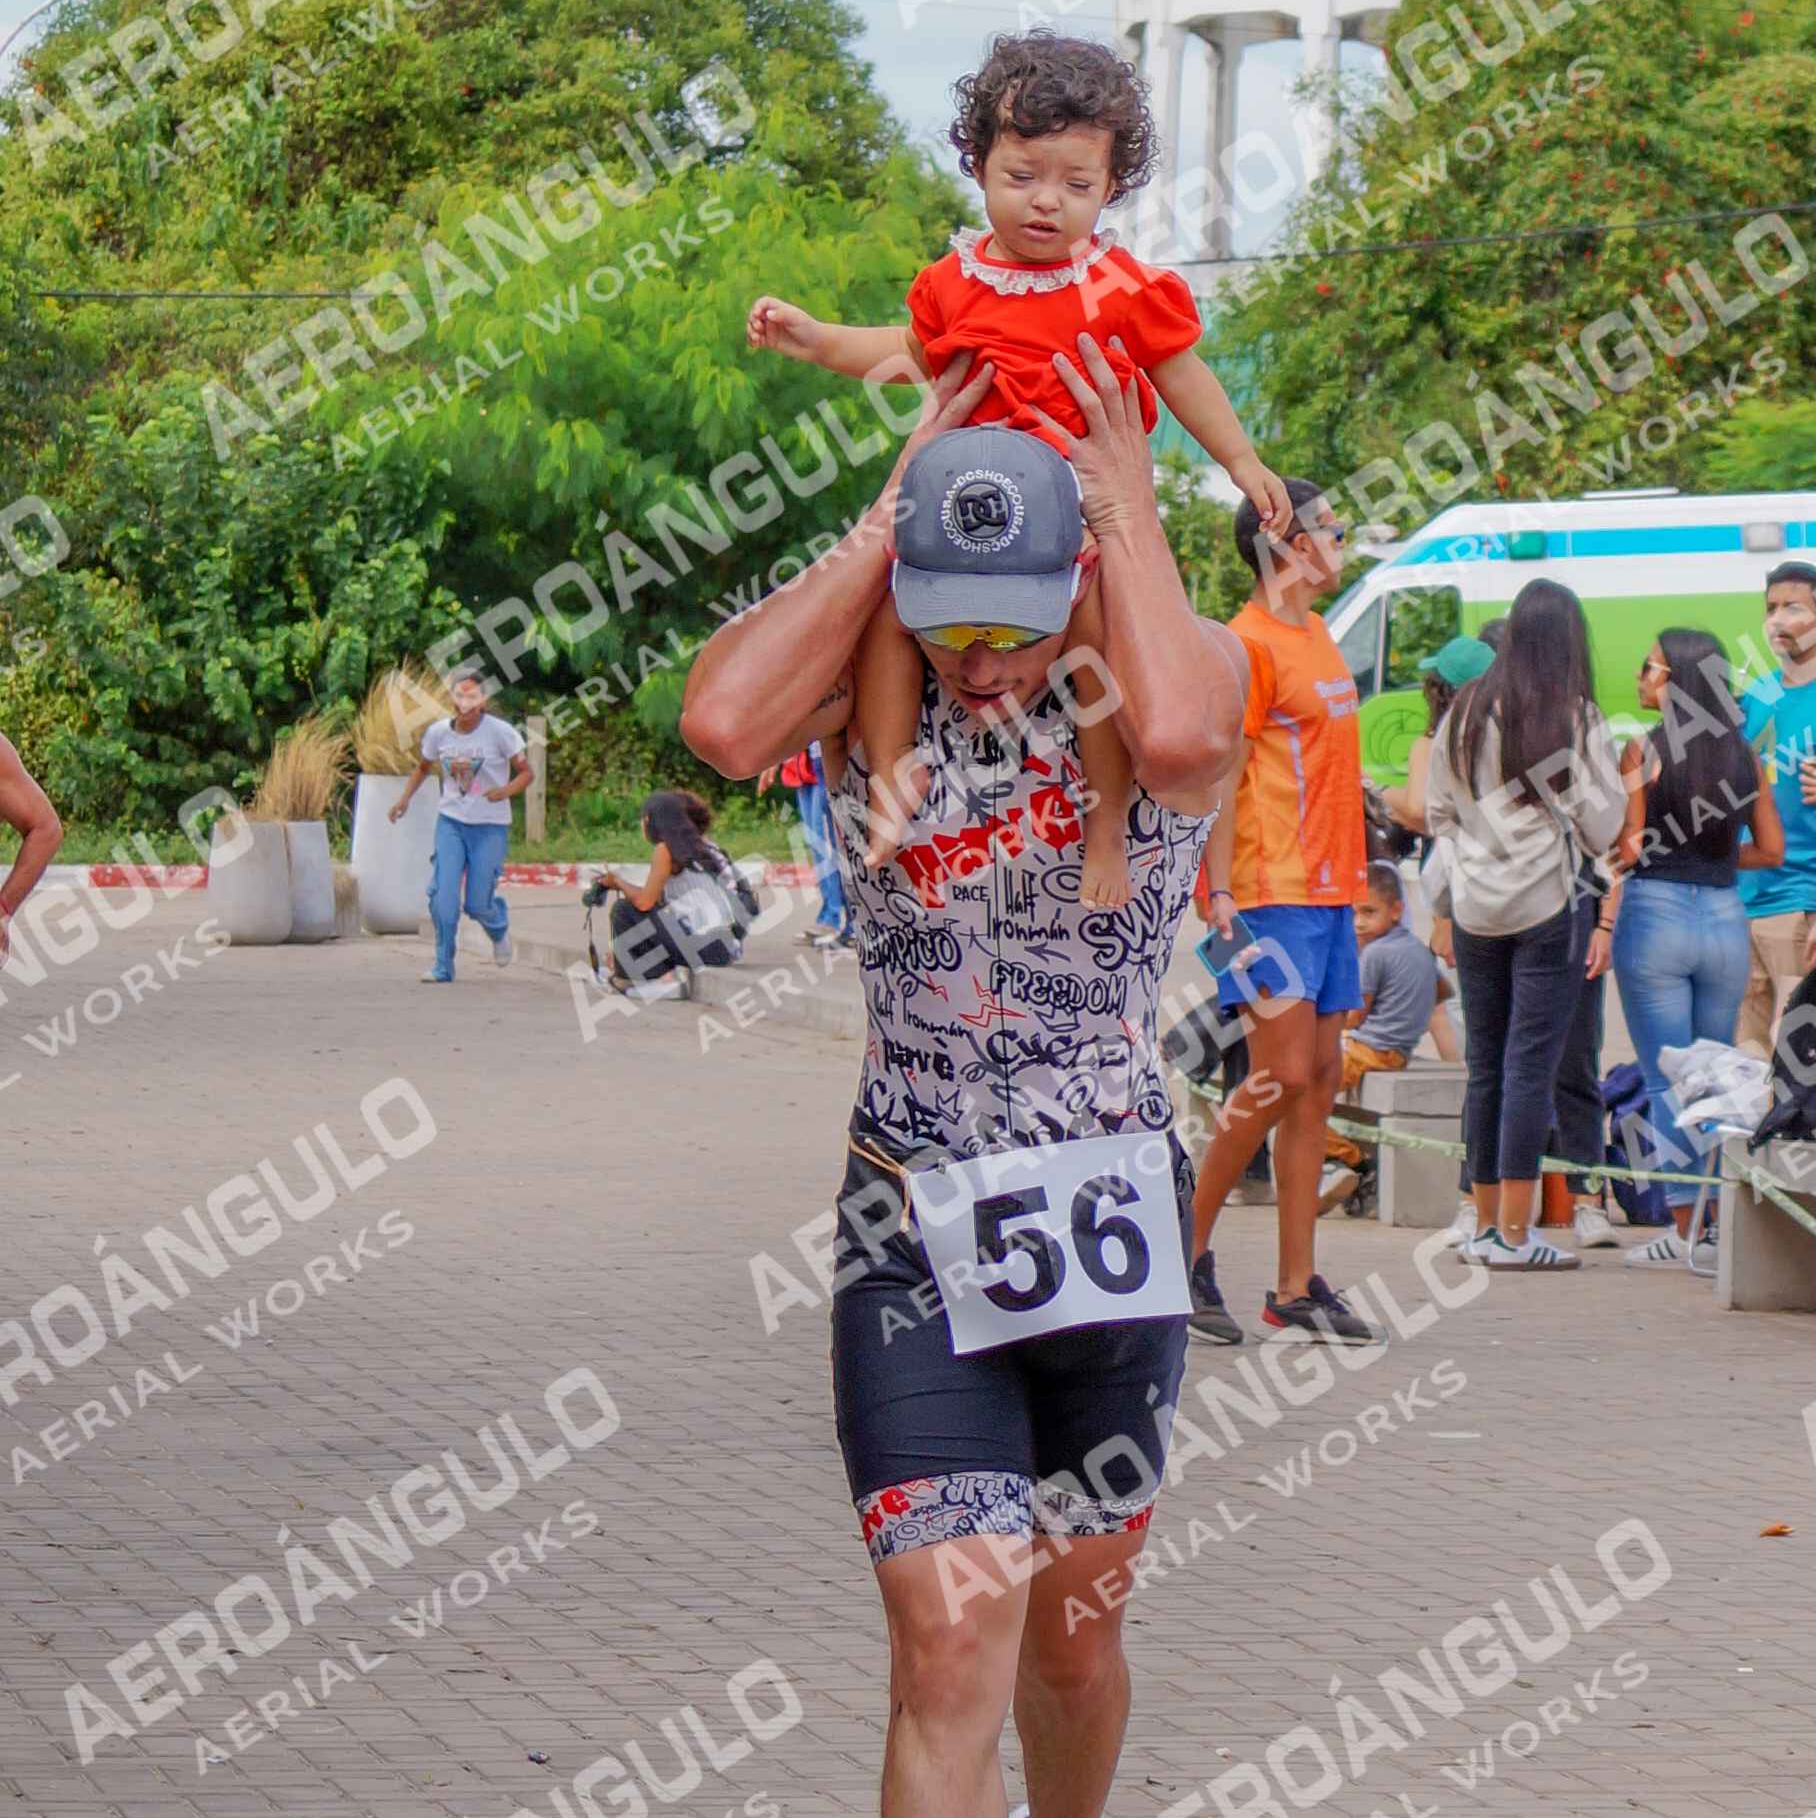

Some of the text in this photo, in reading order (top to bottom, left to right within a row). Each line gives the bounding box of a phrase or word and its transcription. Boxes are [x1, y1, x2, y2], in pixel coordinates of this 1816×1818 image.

[952, 884, 990, 903] RACE
[989, 960, 1128, 1018] FREEDOM
[970, 1173, 1152, 1314] 56
